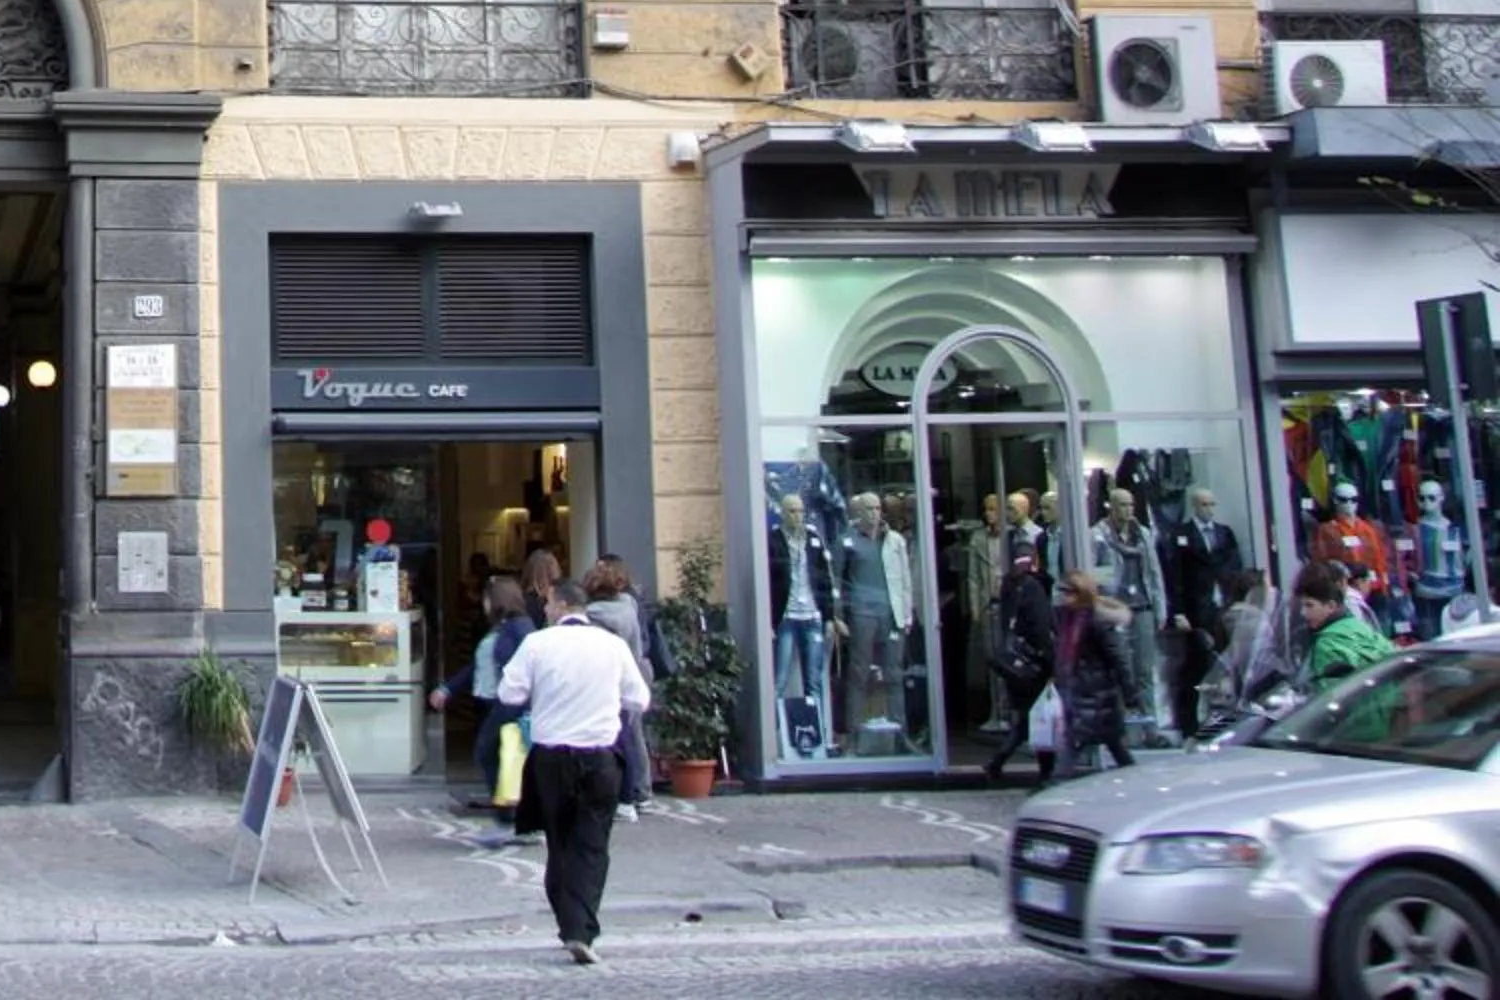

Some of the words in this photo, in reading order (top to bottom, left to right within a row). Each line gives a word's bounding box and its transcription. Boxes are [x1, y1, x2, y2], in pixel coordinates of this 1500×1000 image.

[862, 170, 944, 217] LA
[953, 170, 1116, 217] MELA
[296, 366, 421, 407] Vogue
[872, 366, 895, 381] LA
[900, 366, 947, 381] MA
